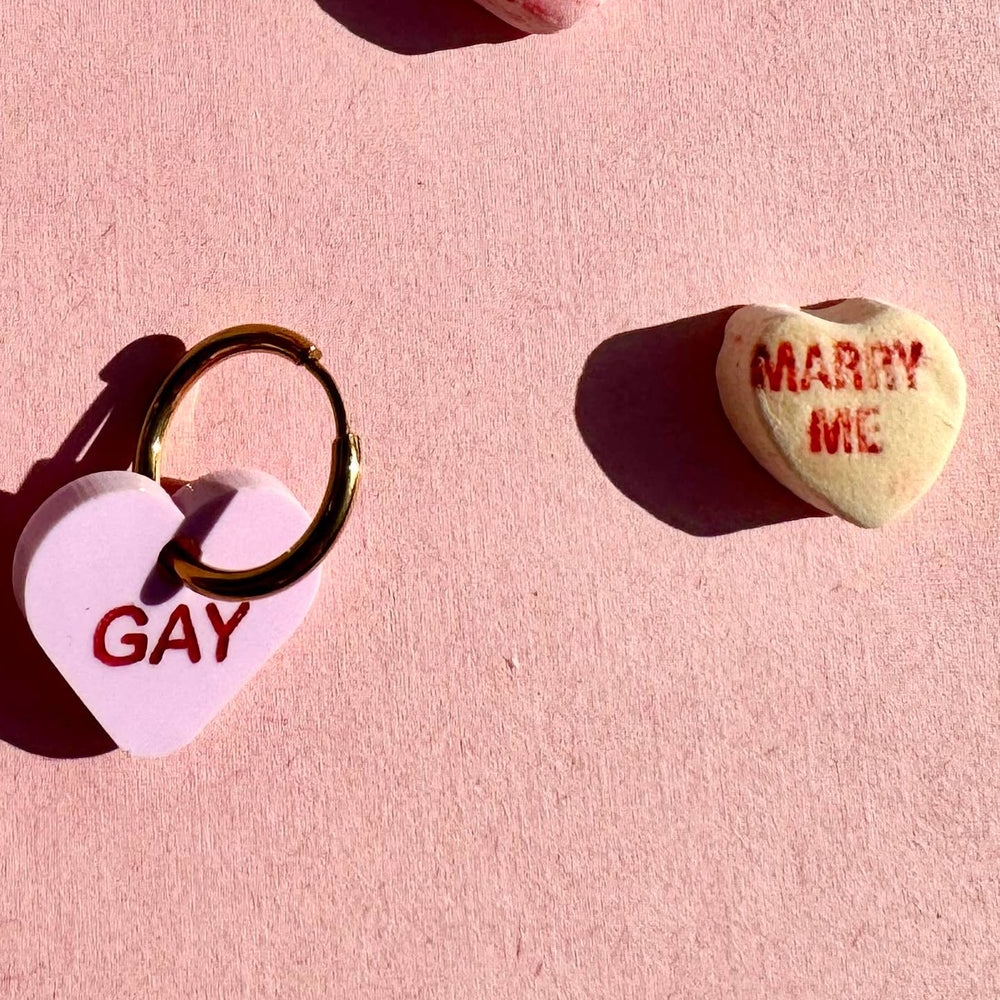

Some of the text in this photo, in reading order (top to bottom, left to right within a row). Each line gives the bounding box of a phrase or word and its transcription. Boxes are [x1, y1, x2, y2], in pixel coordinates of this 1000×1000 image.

[750, 338, 924, 393] MARRY
[807, 407, 884, 456] ME
[92, 601, 250, 668] GAY
